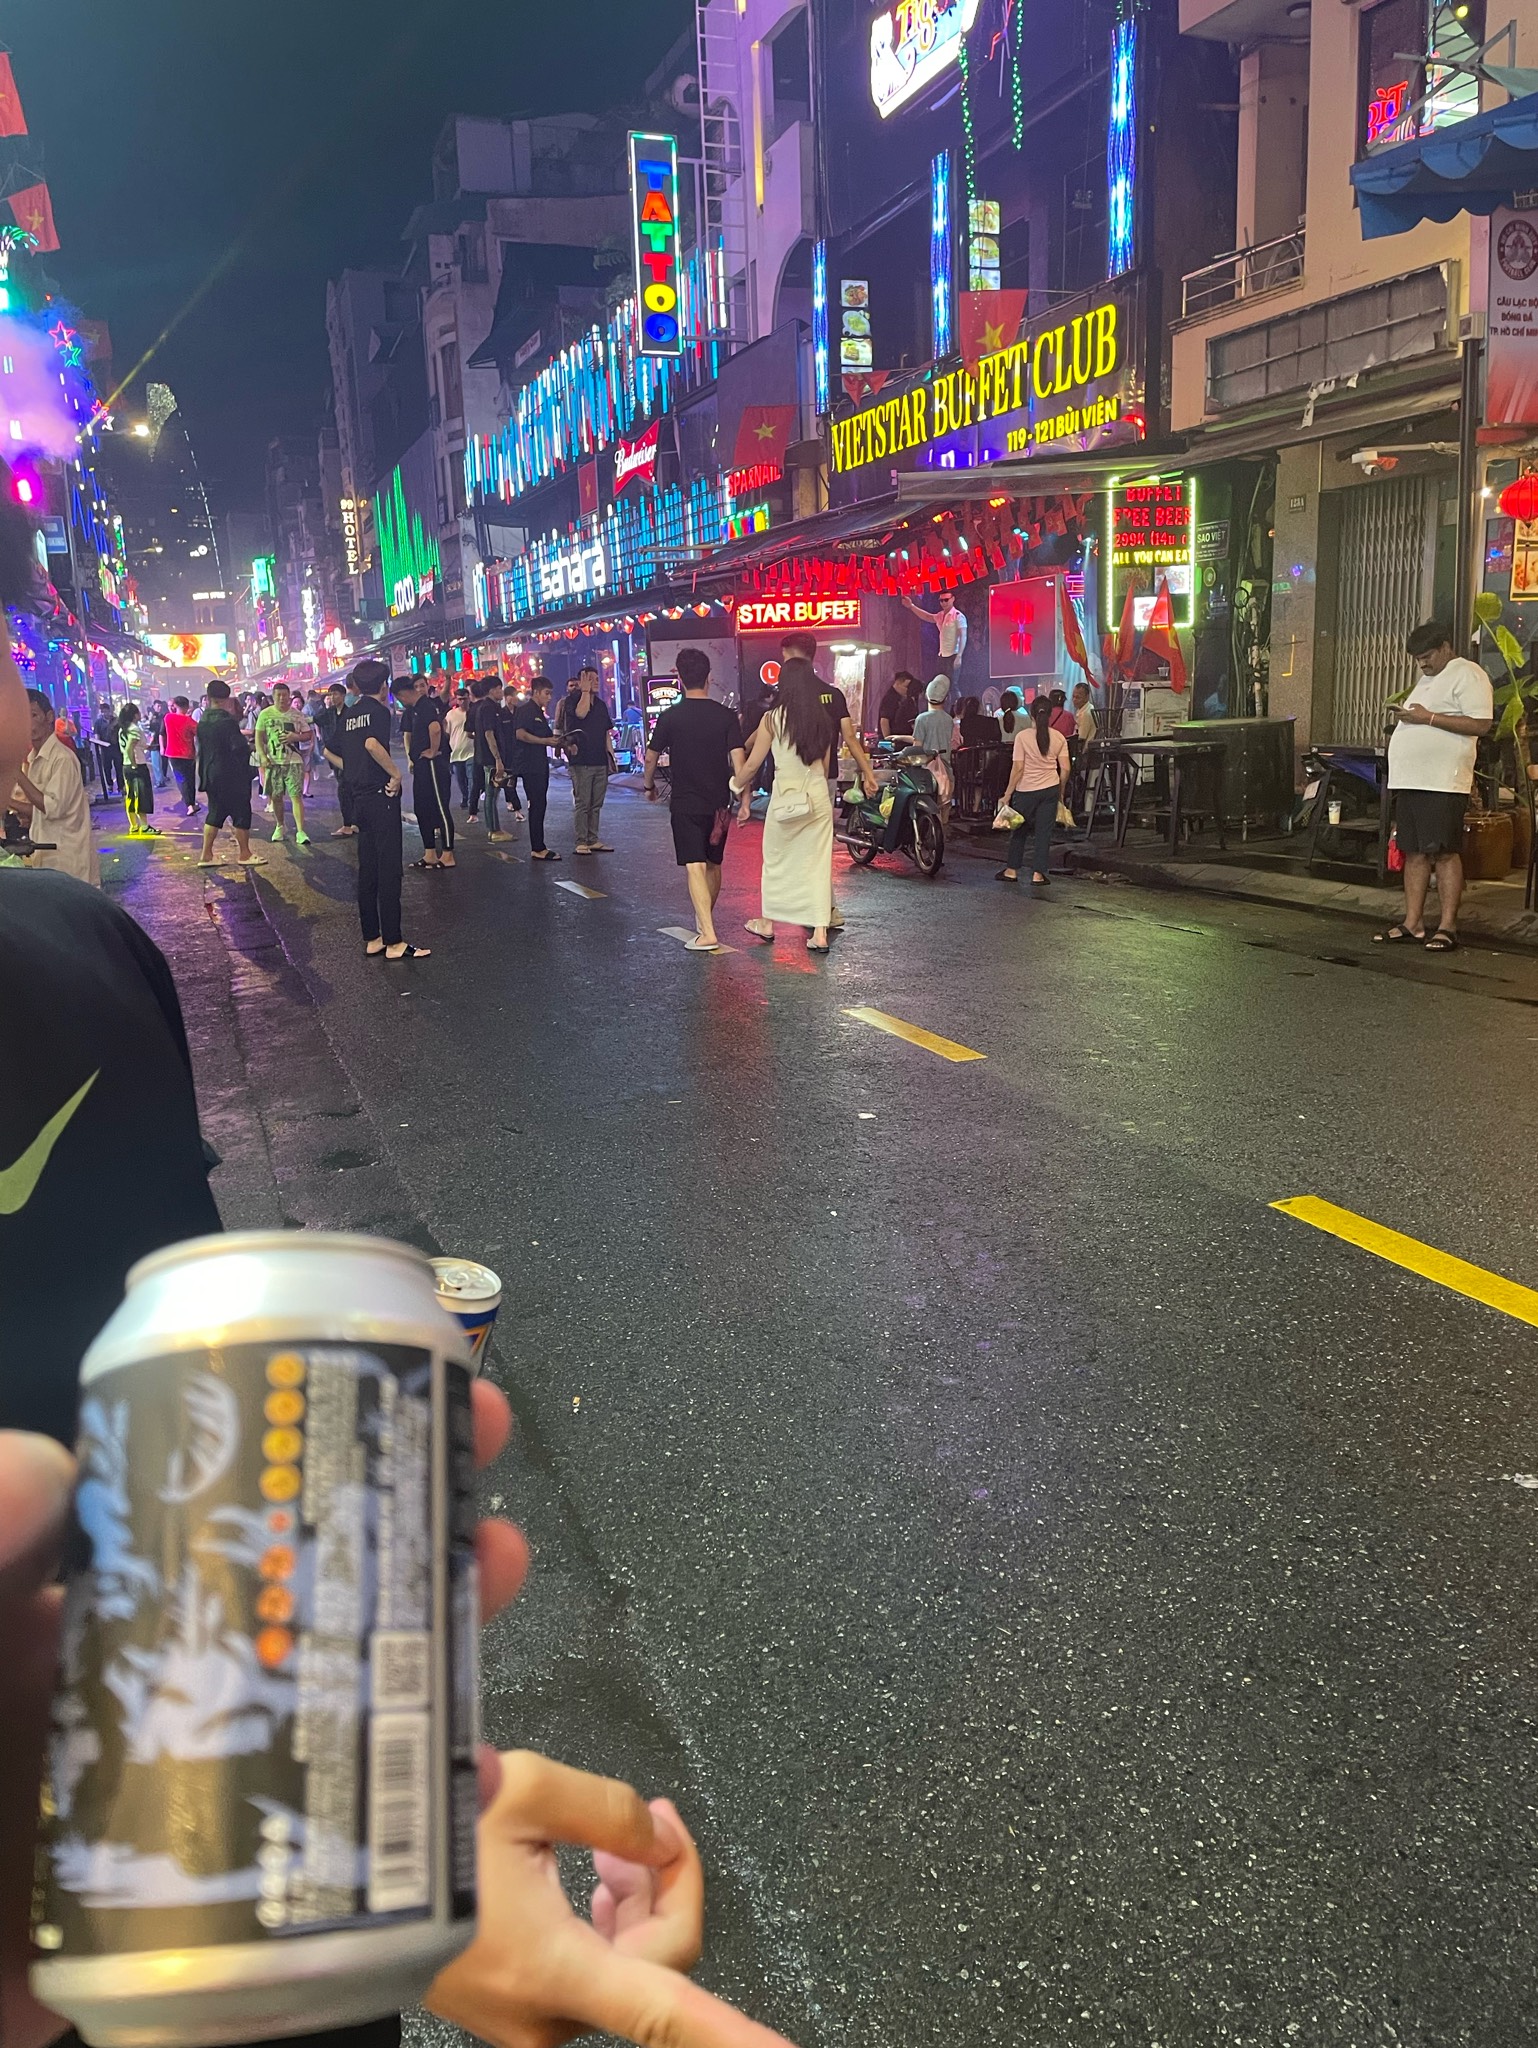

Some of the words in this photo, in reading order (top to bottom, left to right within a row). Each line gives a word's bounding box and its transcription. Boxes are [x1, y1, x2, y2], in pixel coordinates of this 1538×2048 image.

[638, 159, 678, 343] TATTOO
[831, 387, 927, 475] VIETSTAR
[932, 339, 1028, 438] BUFFET
[1033, 303, 1118, 399] CLUB
[1055, 405, 1080, 438] BÙI
[614, 442, 658, 478] Budweiser
[341, 511, 359, 575] HOTEL
[1197, 532, 1211, 544] SAO
[541, 541, 606, 601] sahara
[1112, 551, 1131, 566] ALL
[1133, 550, 1154, 566] YOU
[1154, 549, 1174, 563] CAN
[739, 602, 791, 624] STAR
[794, 600, 858, 622] BUFET
